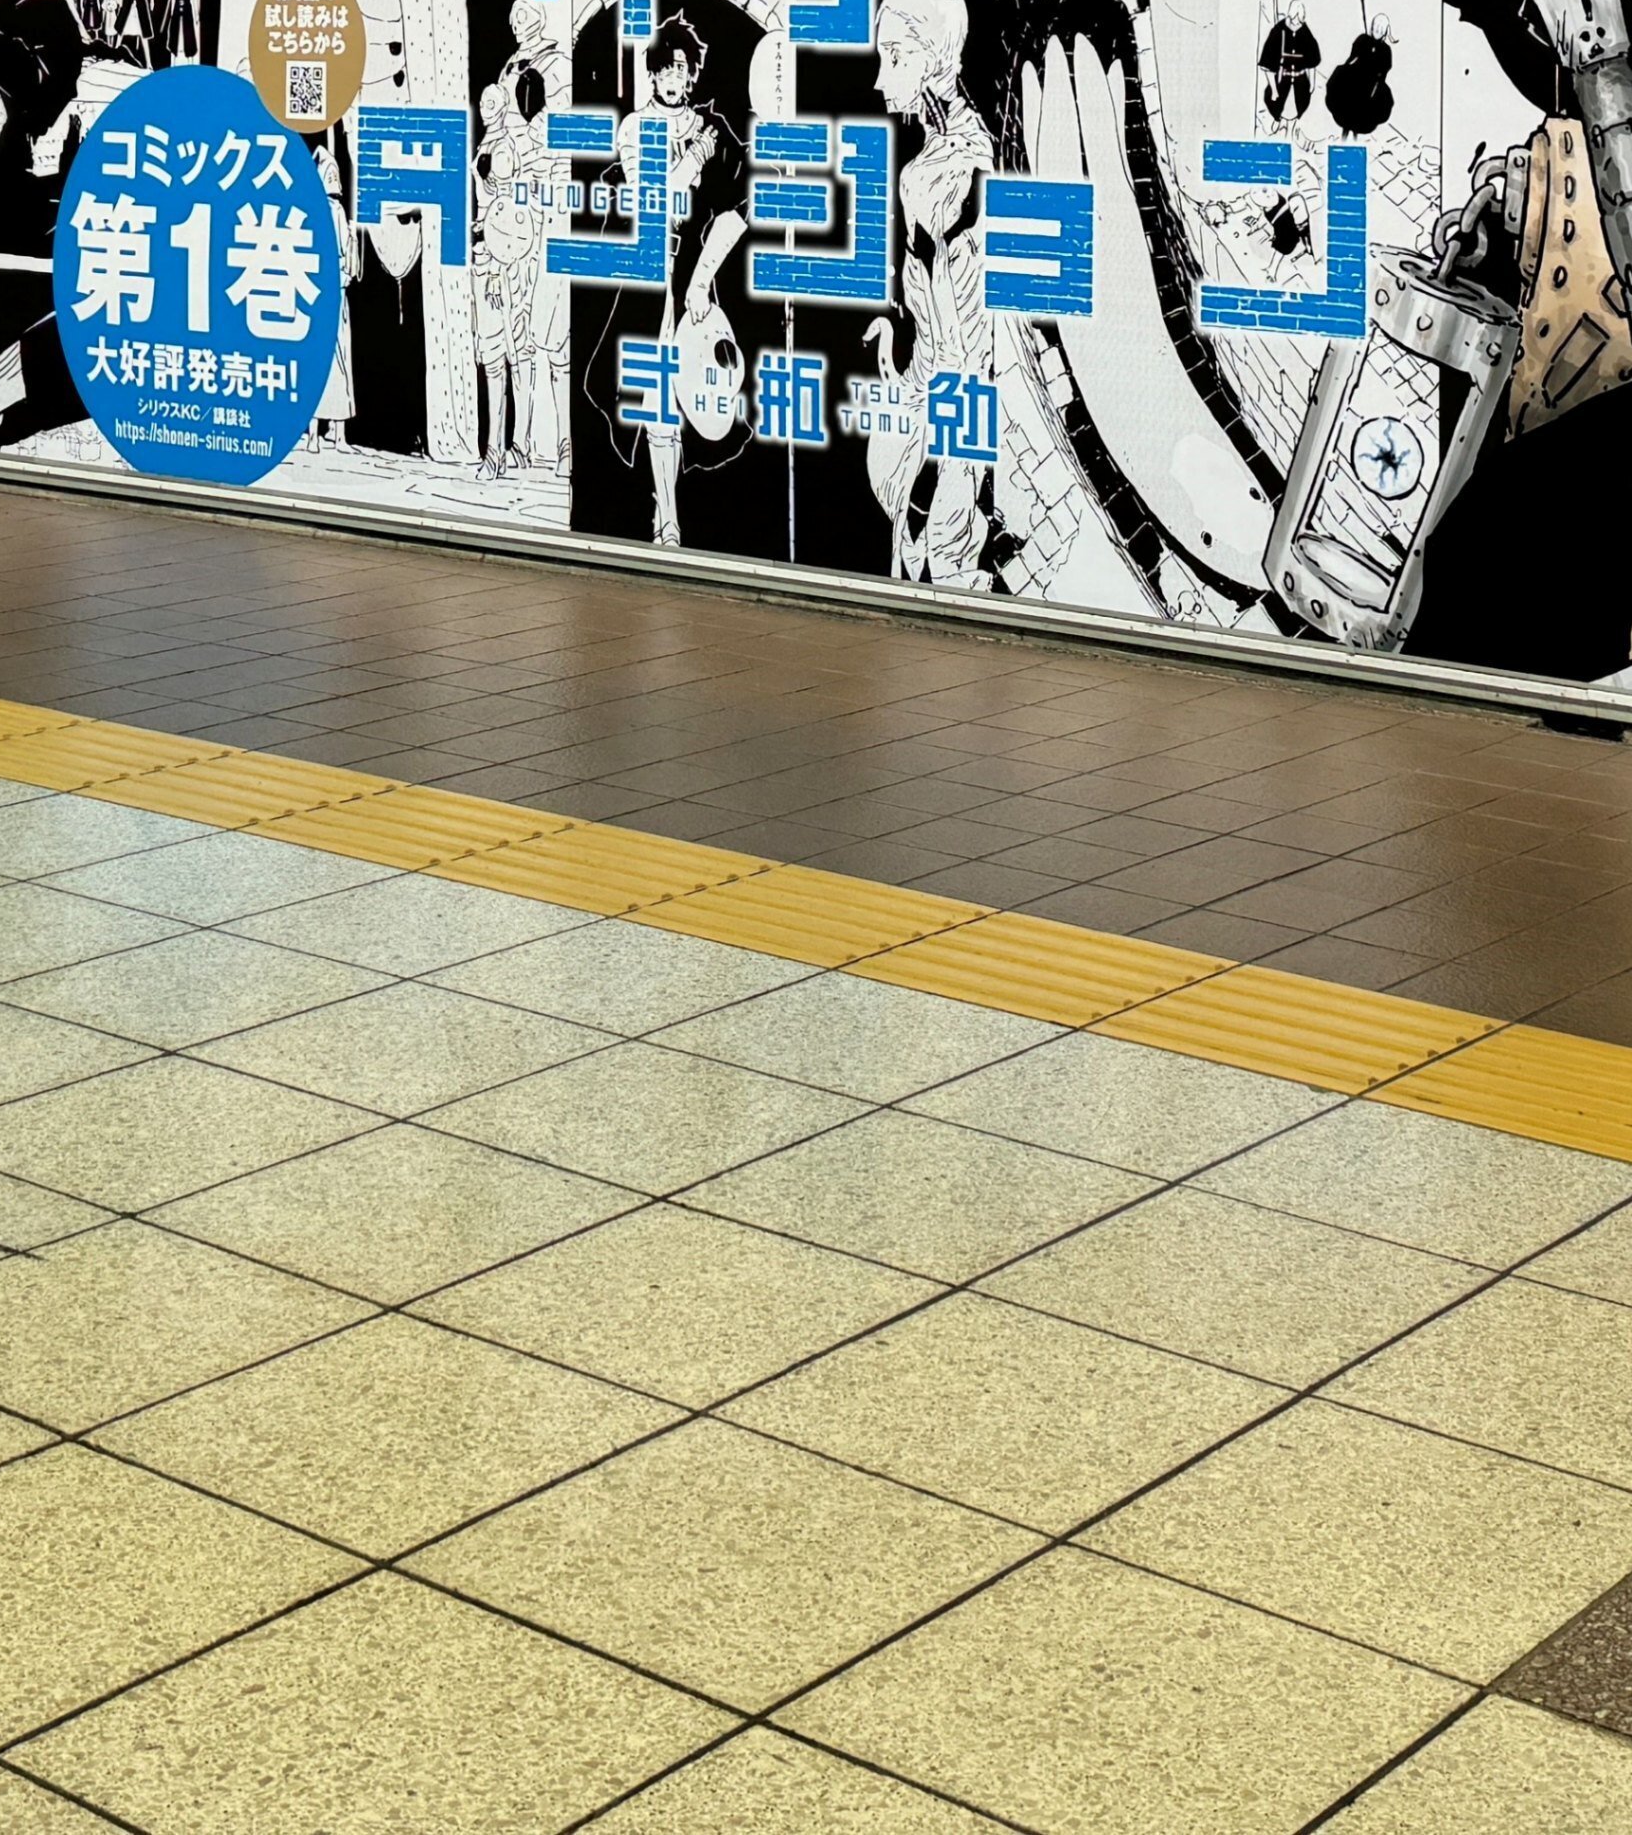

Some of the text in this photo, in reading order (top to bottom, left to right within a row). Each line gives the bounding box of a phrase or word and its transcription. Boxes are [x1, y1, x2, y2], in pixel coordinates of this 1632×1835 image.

[264, 4, 349, 29] 試し読みは
[267, 31, 346, 55] こちらから
[101, 123, 294, 191] コミックス
[515, 182, 691, 215] DUNGEON
[357, 106, 1368, 338] ダンジョン
[70, 191, 321, 342] 第1巻
[705, 366, 733, 388] NI
[694, 392, 744, 419] HEI
[850, 381, 902, 405] TSU
[840, 409, 911, 435] TOMU
[114, 418, 275, 458] https://shonen-sirius.com/
